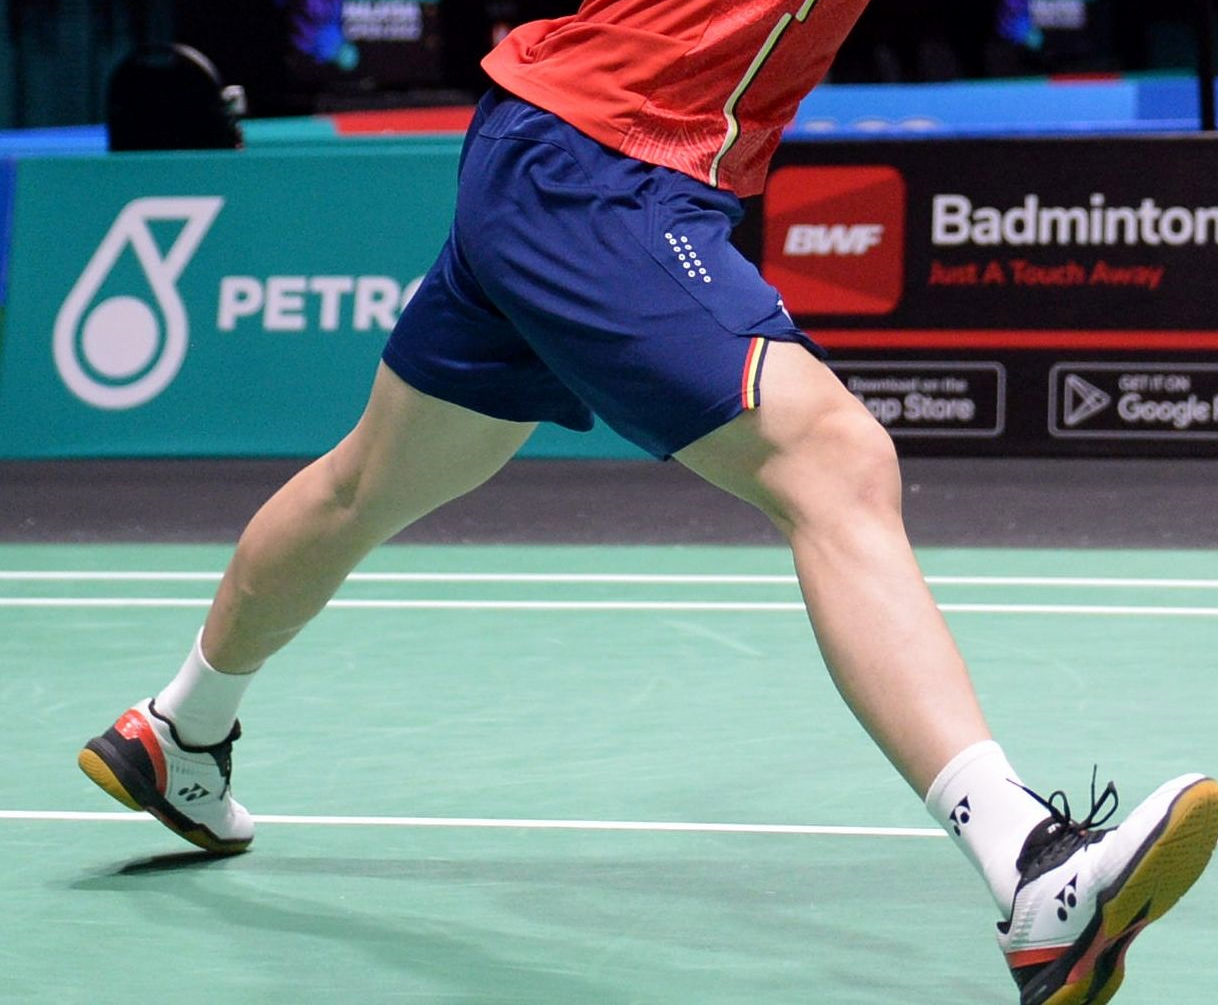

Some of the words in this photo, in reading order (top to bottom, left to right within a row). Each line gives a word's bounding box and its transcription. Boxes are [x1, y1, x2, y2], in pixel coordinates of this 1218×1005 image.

[784, 223, 883, 255] BWF
[929, 260, 978, 286] Just
[983, 260, 1005, 284] A
[1009, 259, 1086, 286] Touch
[1090, 260, 1163, 289] Away
[1118, 374, 1148, 391] GET
[904, 392, 976, 421] Store
[1117, 392, 1211, 429] Google
